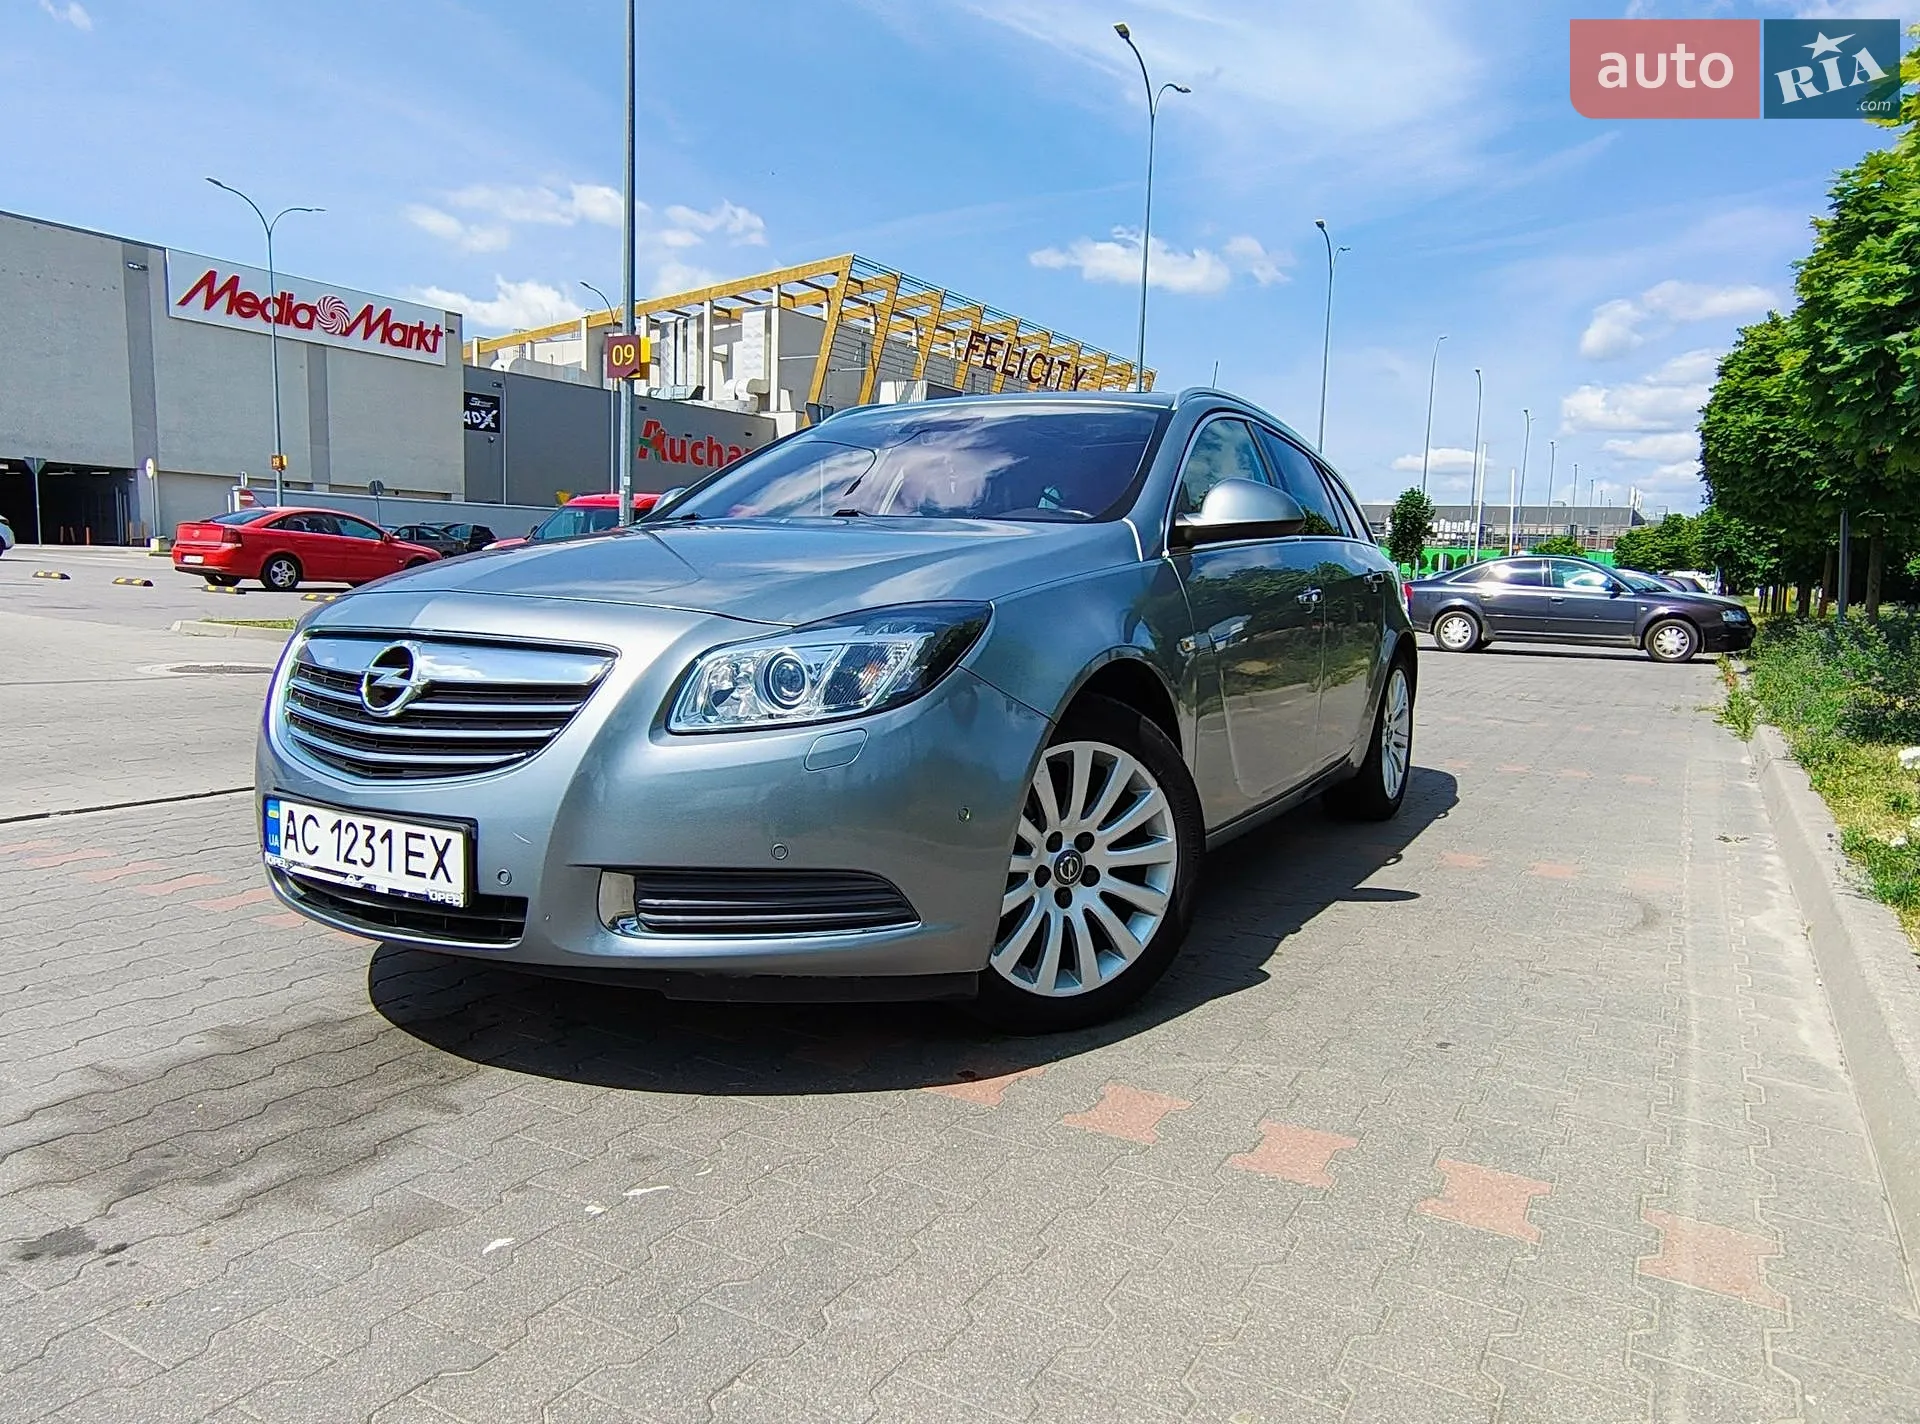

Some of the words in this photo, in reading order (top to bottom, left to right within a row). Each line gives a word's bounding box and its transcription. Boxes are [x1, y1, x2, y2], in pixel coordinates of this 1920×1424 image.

[176, 269, 318, 331] Media
[341, 303, 443, 354] Markt
[611, 344, 635, 367] 09
[963, 329, 1088, 392] FELICITY
[637, 419, 753, 468] Aucha
[268, 833, 280, 848] UA
[284, 809, 321, 856] AC
[329, 818, 393, 874] 1231
[404, 831, 454, 884] EX
